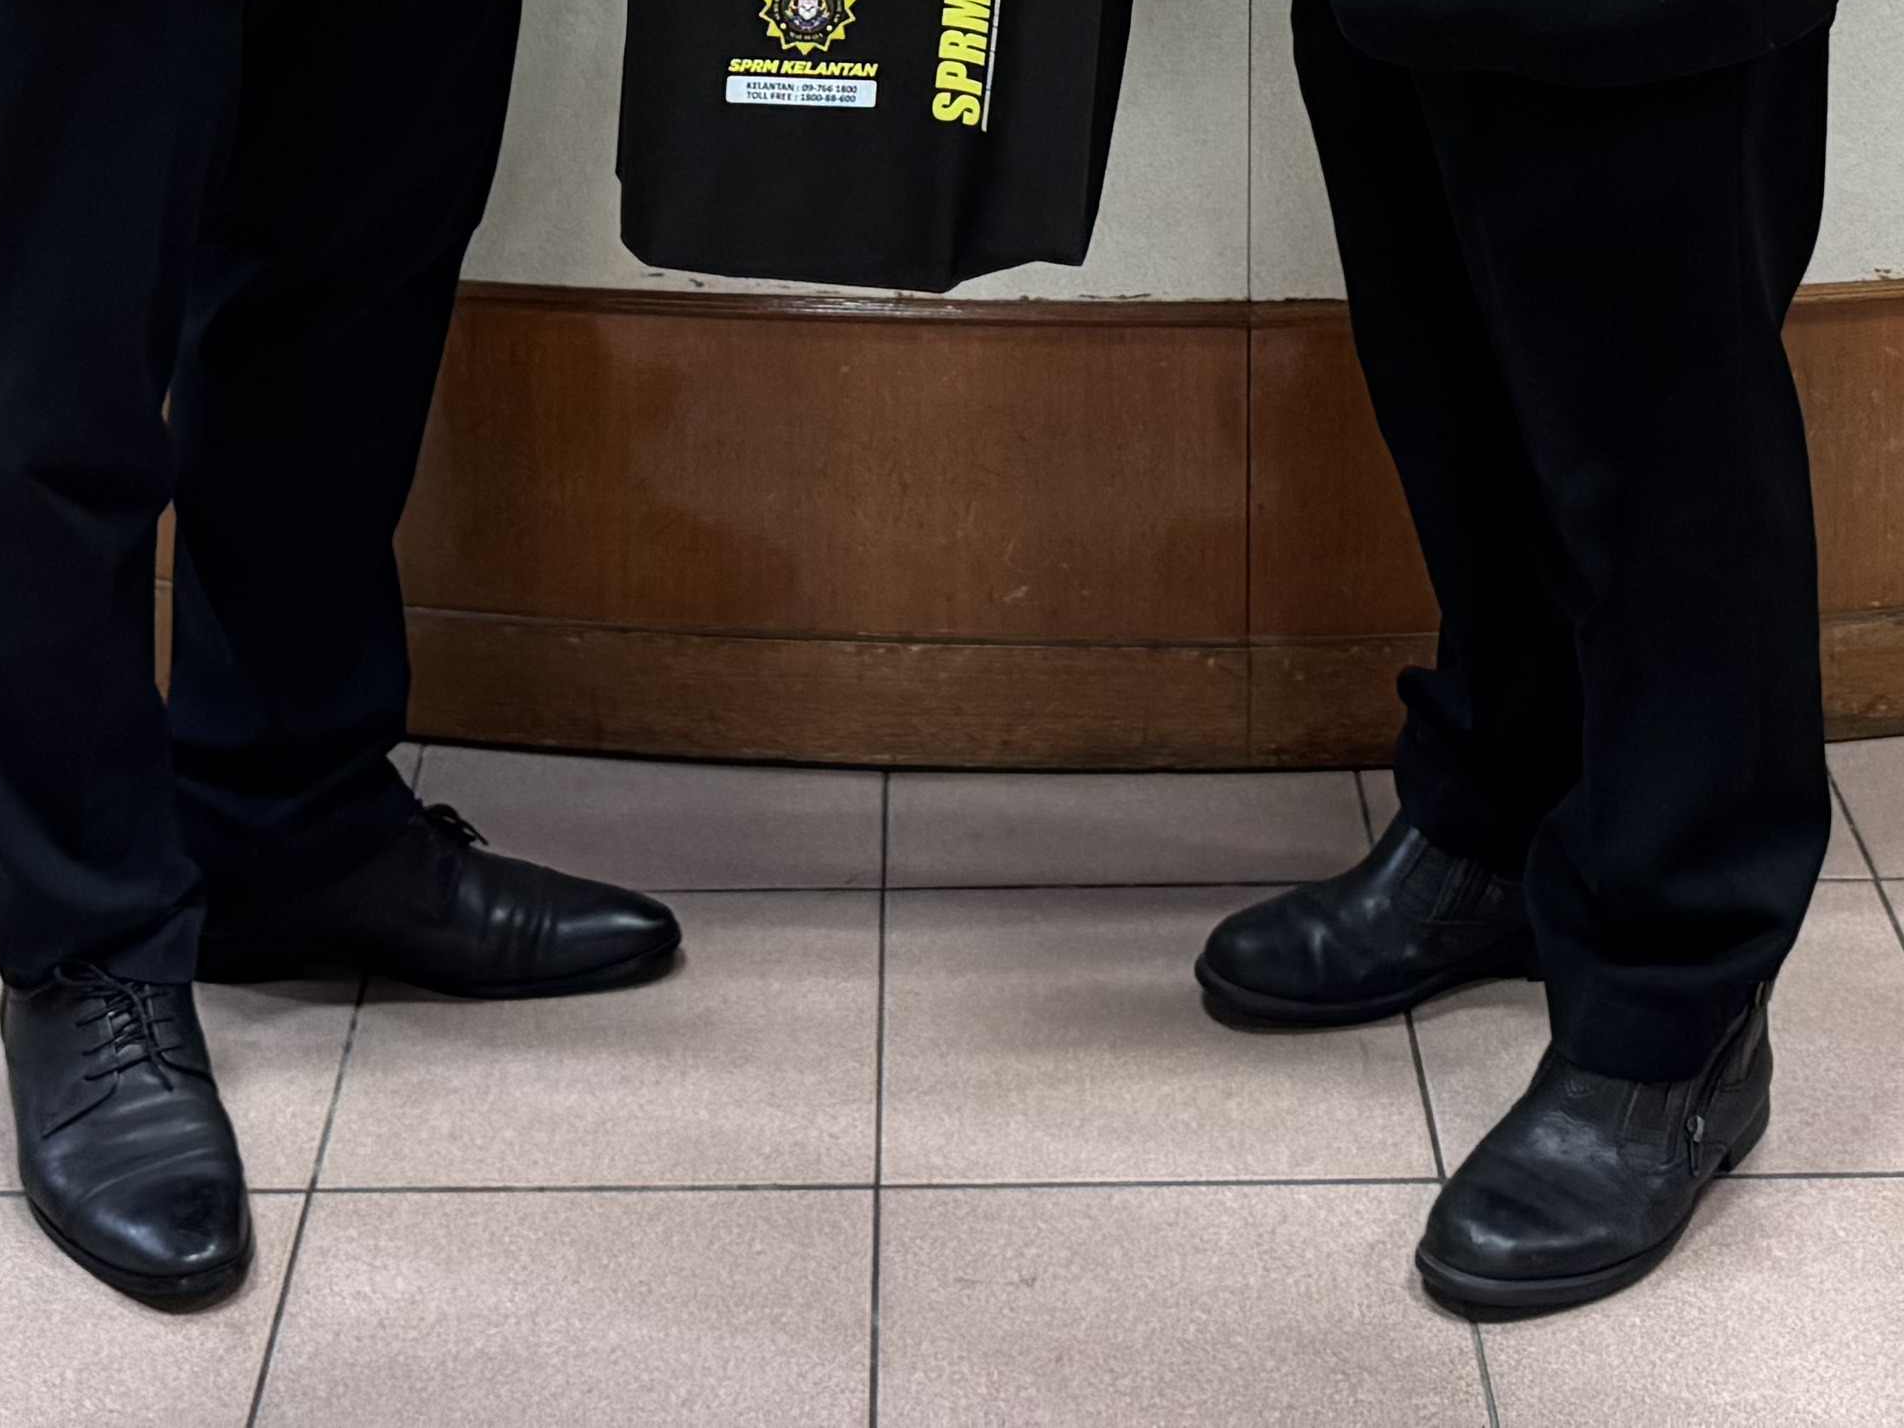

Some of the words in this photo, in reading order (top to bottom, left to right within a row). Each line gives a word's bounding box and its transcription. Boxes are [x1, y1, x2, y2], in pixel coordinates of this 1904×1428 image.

[727, 58, 780, 74] SPRM
[780, 59, 879, 77] KELANTAN
[746, 81, 795, 92] KELANTAN
[746, 91, 769, 101] TOLL
